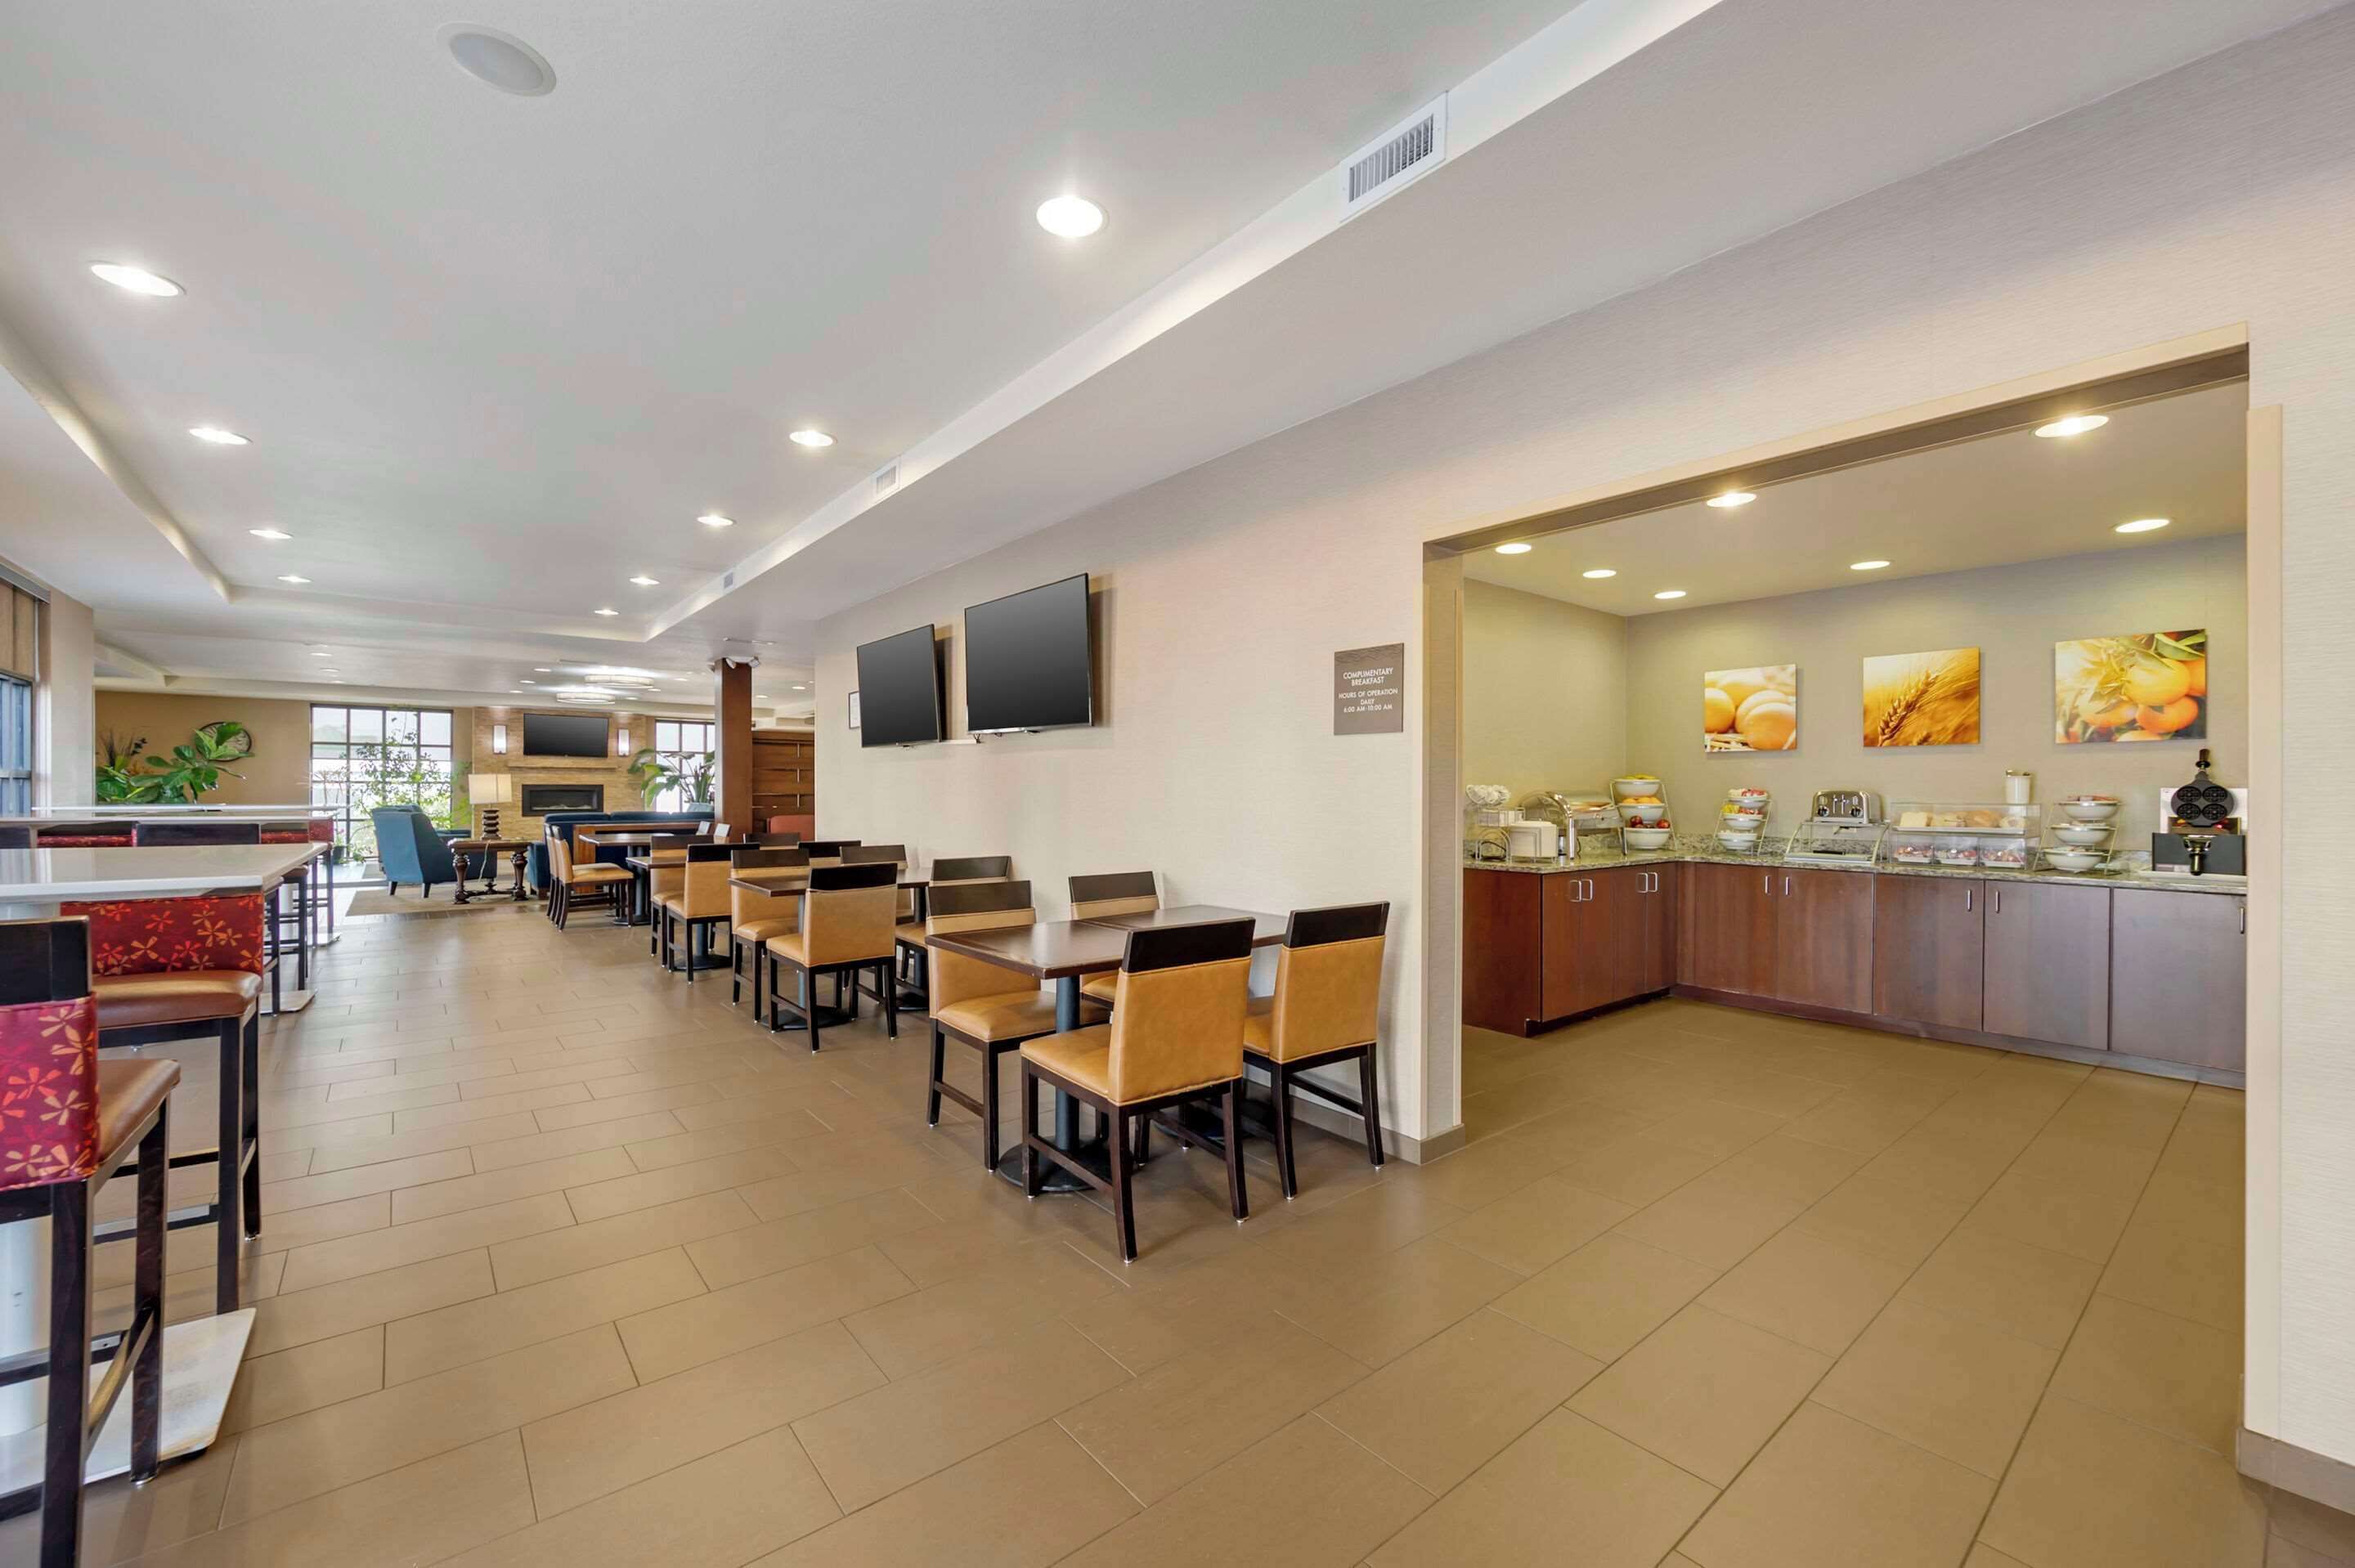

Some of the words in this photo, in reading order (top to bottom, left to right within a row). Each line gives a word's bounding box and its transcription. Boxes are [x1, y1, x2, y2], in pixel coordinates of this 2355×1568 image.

[1343, 667, 1393, 679] COMPLIMENTARY
[1351, 676, 1384, 687] BREAKFAST
[1366, 688, 1398, 697] OPERATION
